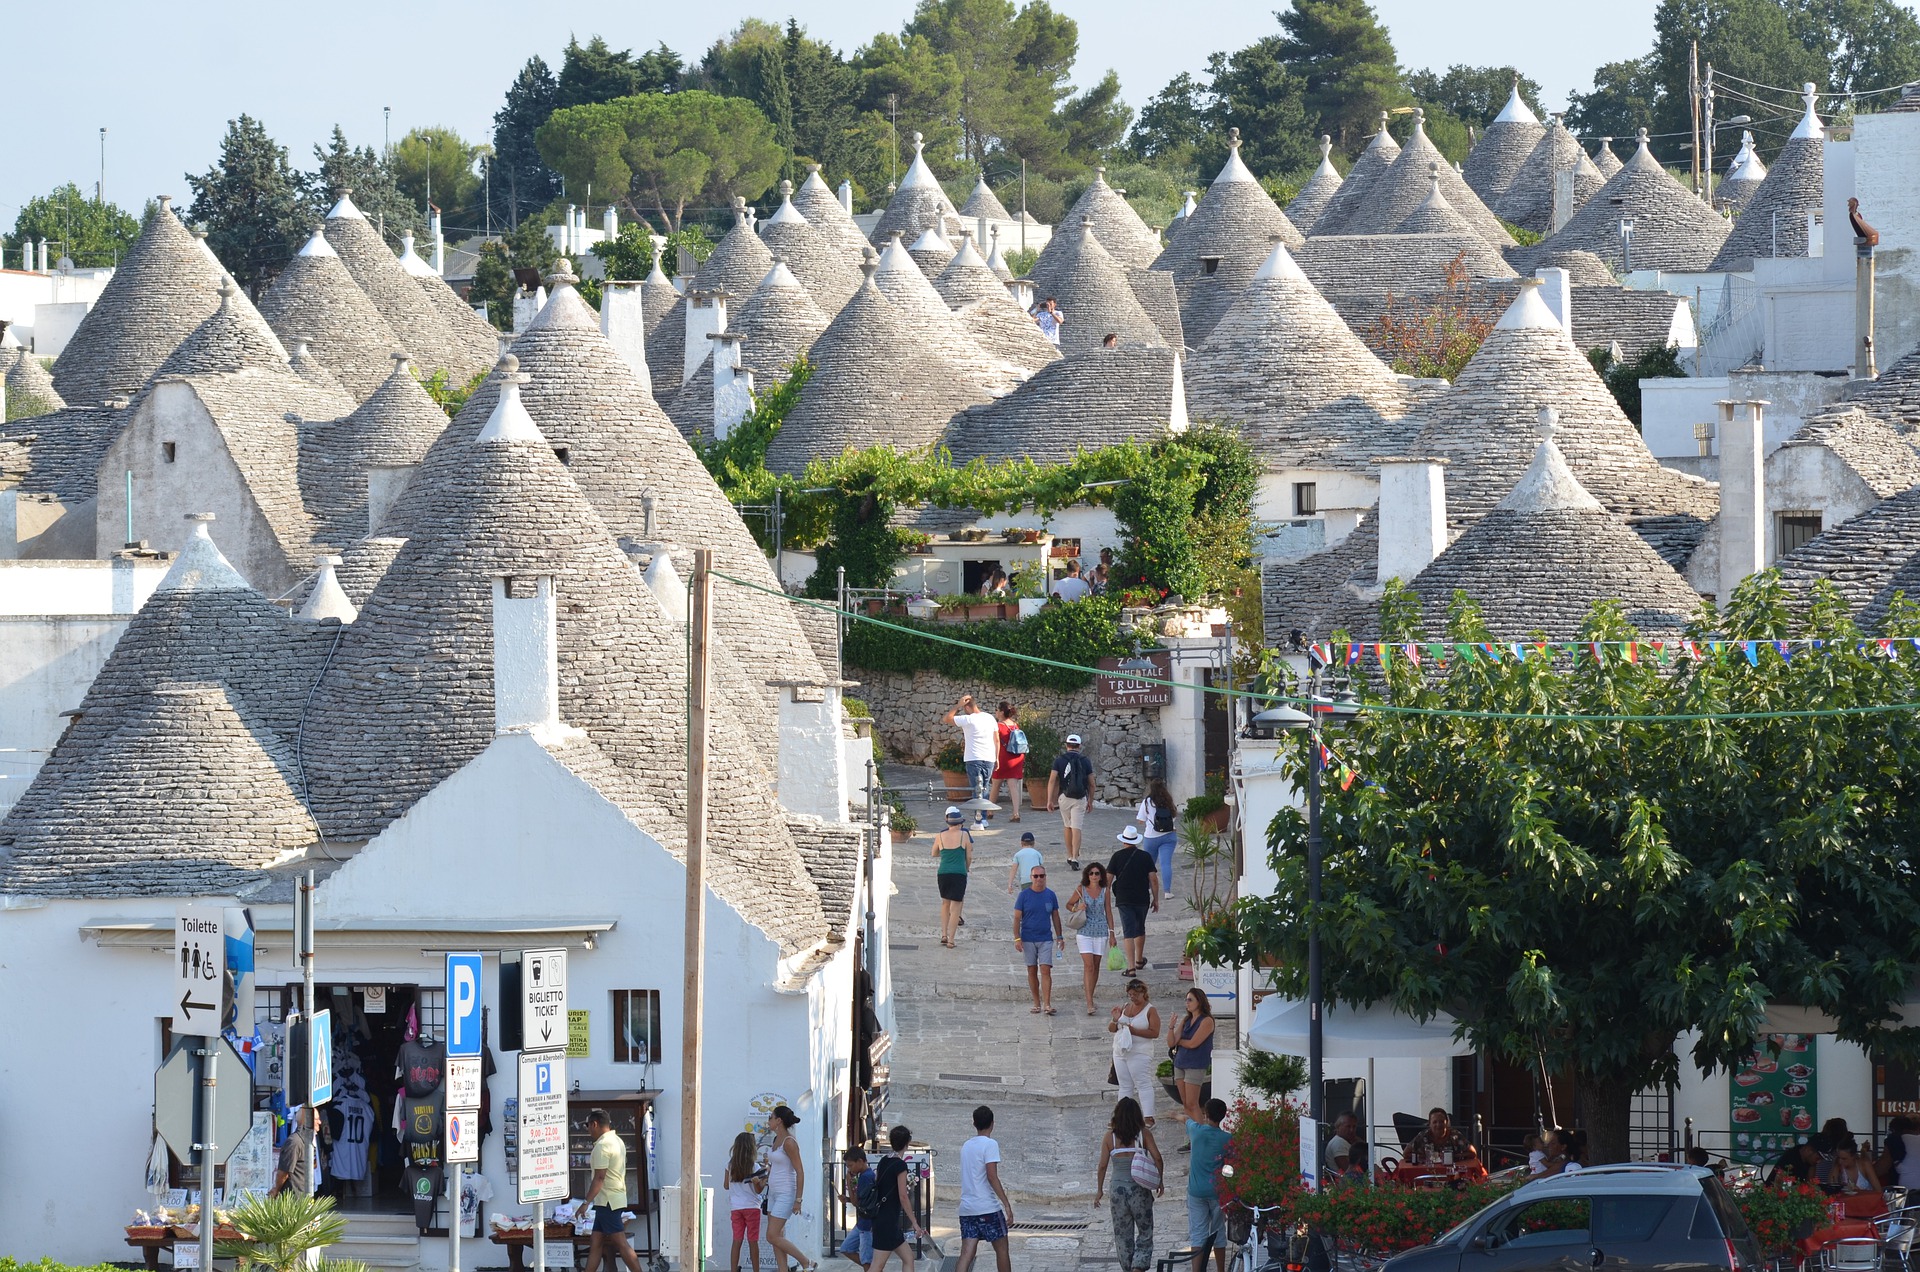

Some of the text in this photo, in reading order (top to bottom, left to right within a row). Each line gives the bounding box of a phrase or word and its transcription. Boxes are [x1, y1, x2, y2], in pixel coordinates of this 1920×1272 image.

[1100, 667, 1164, 680] MONUMETALE
[1109, 678, 1158, 690] TRULLI
[1100, 693, 1168, 706] CHIESA A TRULLI
[181, 917, 218, 934] Toilette
[529, 990, 563, 1004] BIGLIETTO
[453, 964, 476, 1045] P
[535, 1005, 558, 1017] TICKET
[521, 1056, 538, 1064] Comune
[538, 1066, 548, 1092] P
[1881, 1101, 1920, 1113] INSA
[347, 1115, 365, 1144] 10
